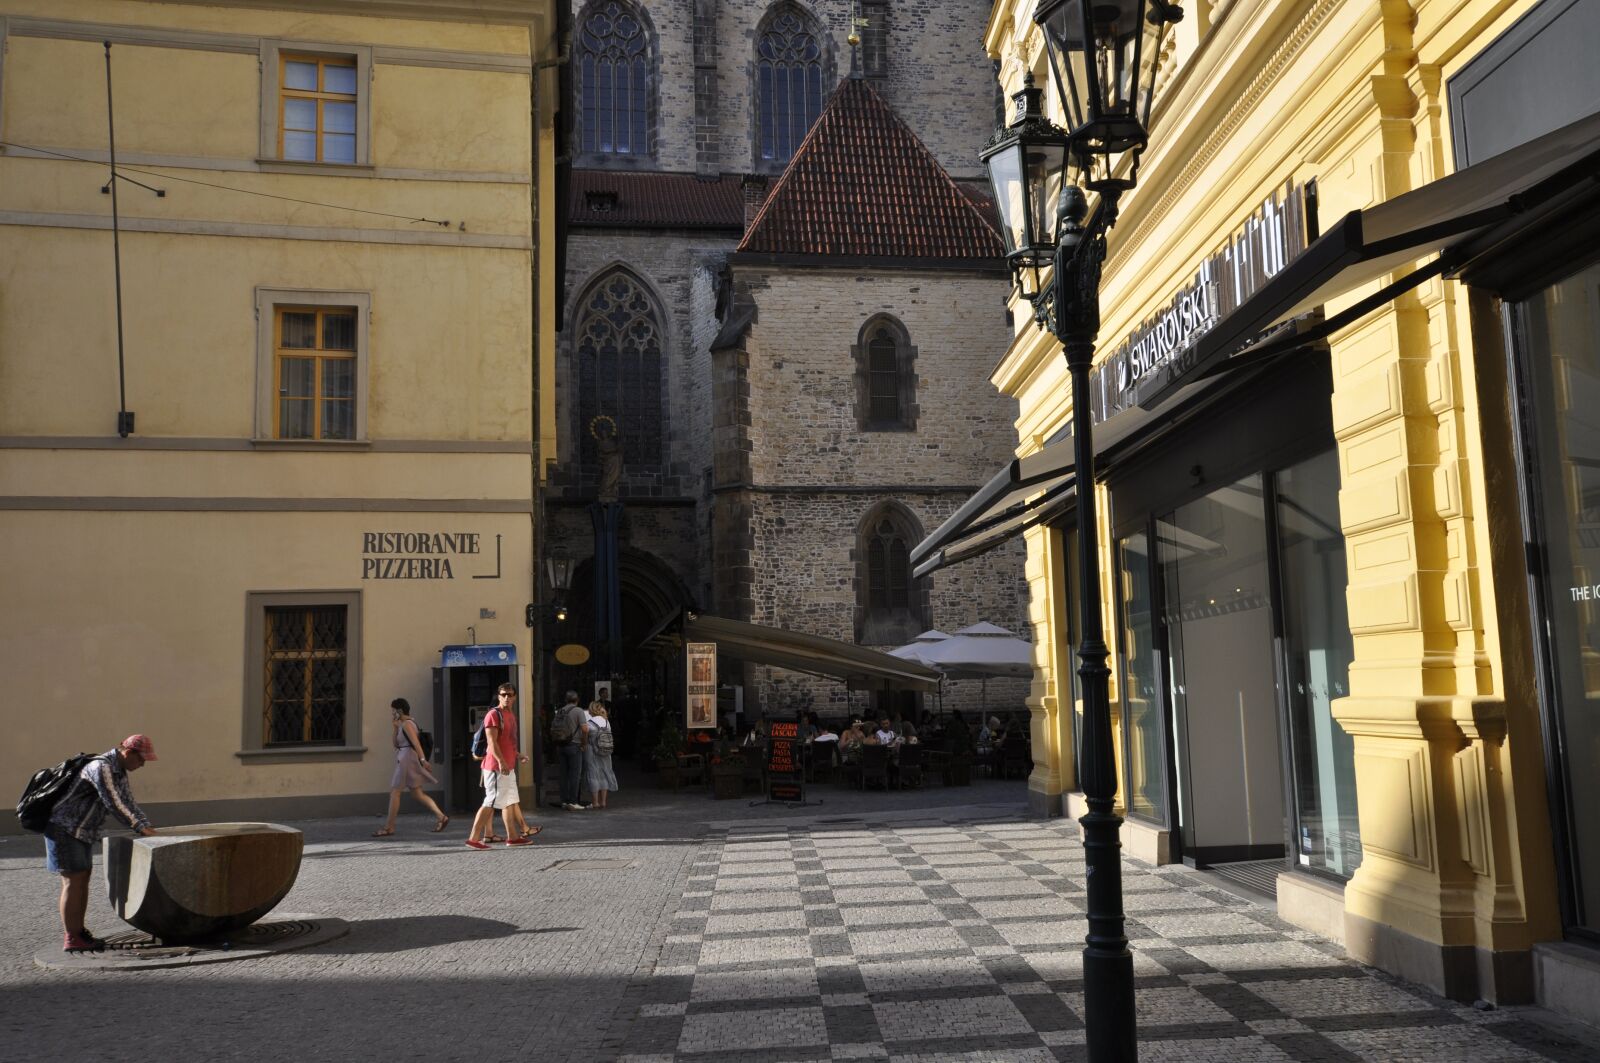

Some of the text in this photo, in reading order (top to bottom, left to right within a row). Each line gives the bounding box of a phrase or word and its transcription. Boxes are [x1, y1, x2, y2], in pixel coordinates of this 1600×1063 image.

[1131, 282, 1209, 380] SWAROVSKI
[362, 532, 480, 554] RISTORANTE
[361, 558, 454, 579] PIZZERIA
[1570, 585, 1590, 602] THE
[773, 749, 791, 757] PASTA
[774, 741, 791, 749] PIZZA
